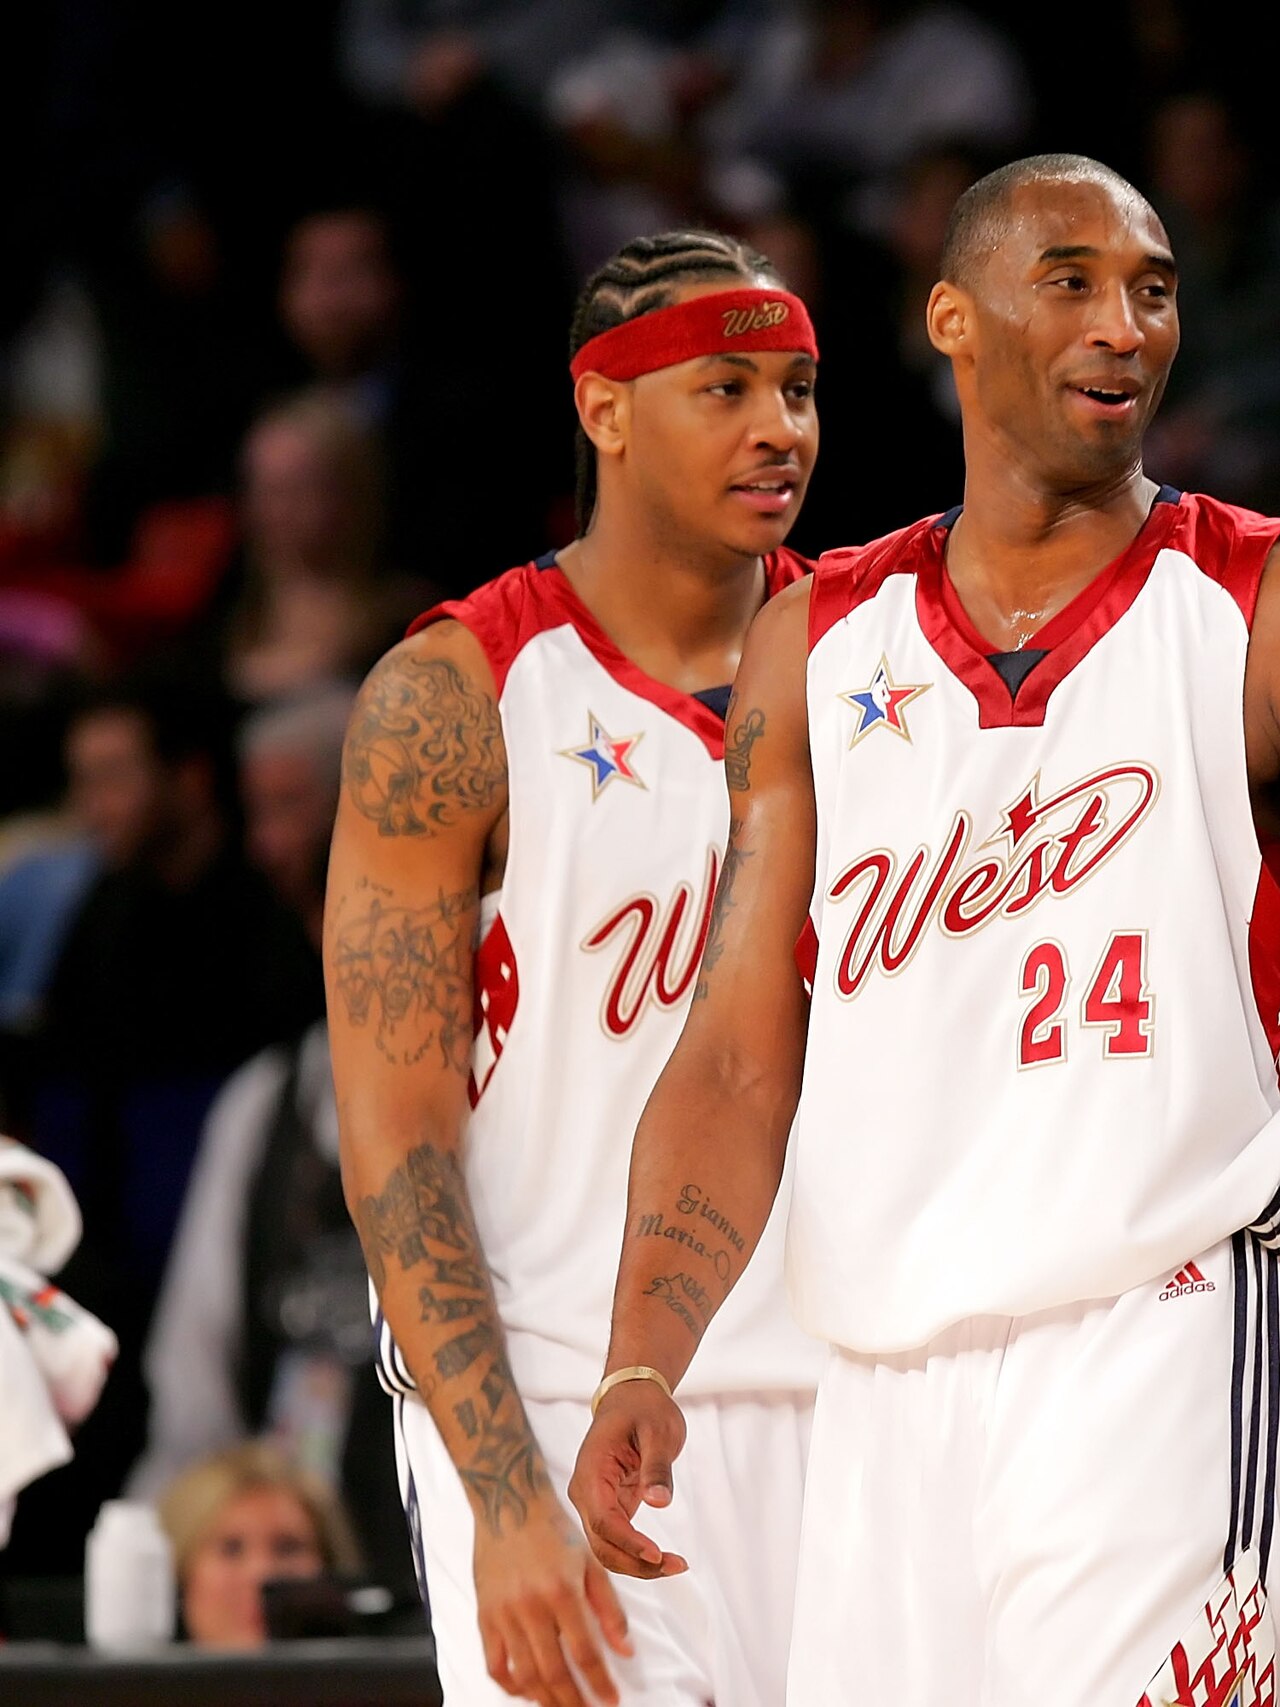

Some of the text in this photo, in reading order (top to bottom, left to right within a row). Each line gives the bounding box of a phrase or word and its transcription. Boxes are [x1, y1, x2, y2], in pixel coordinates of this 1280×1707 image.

[722, 301, 789, 338] West
[826, 760, 1160, 1003] West
[579, 842, 718, 1043] W
[1016, 928, 1156, 1072] 24
[676, 1184, 746, 1254] Gianna
[1159, 1281, 1216, 1301] adidas
